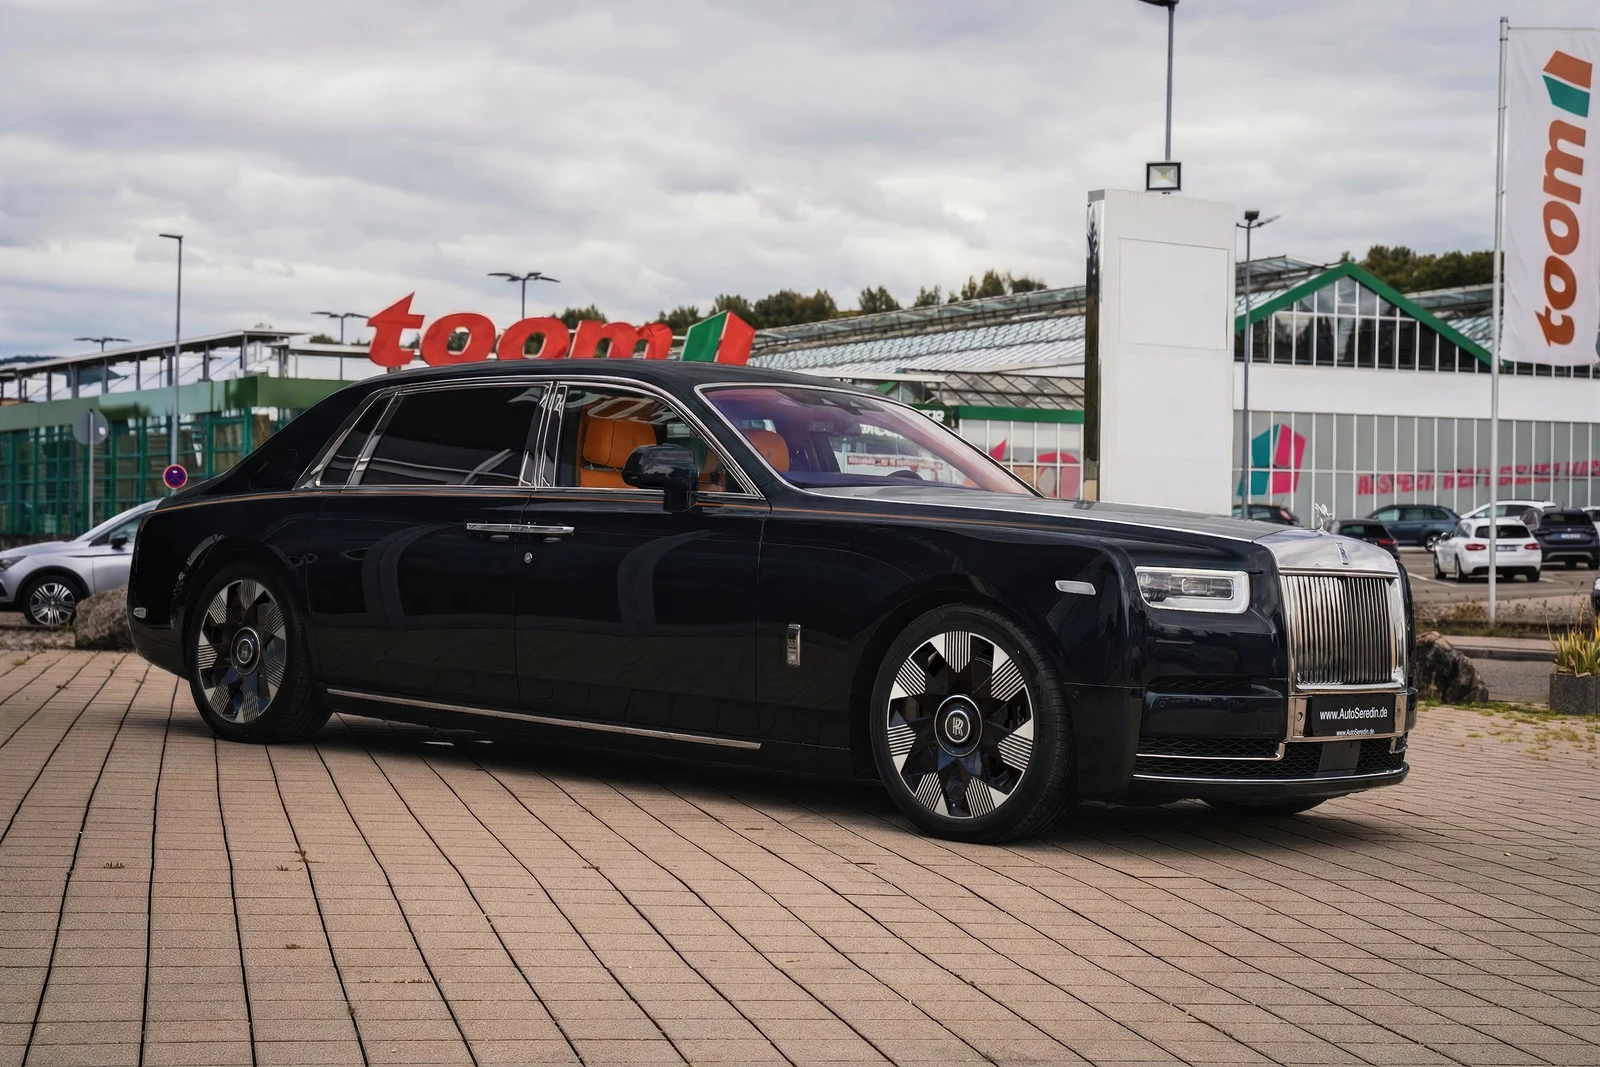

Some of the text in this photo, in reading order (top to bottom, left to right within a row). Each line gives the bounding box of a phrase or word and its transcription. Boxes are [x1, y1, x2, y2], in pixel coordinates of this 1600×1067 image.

[1534, 119, 1587, 347] toom
[366, 291, 673, 367] toom
[1319, 706, 1388, 720] www.AutoSeredin.de
